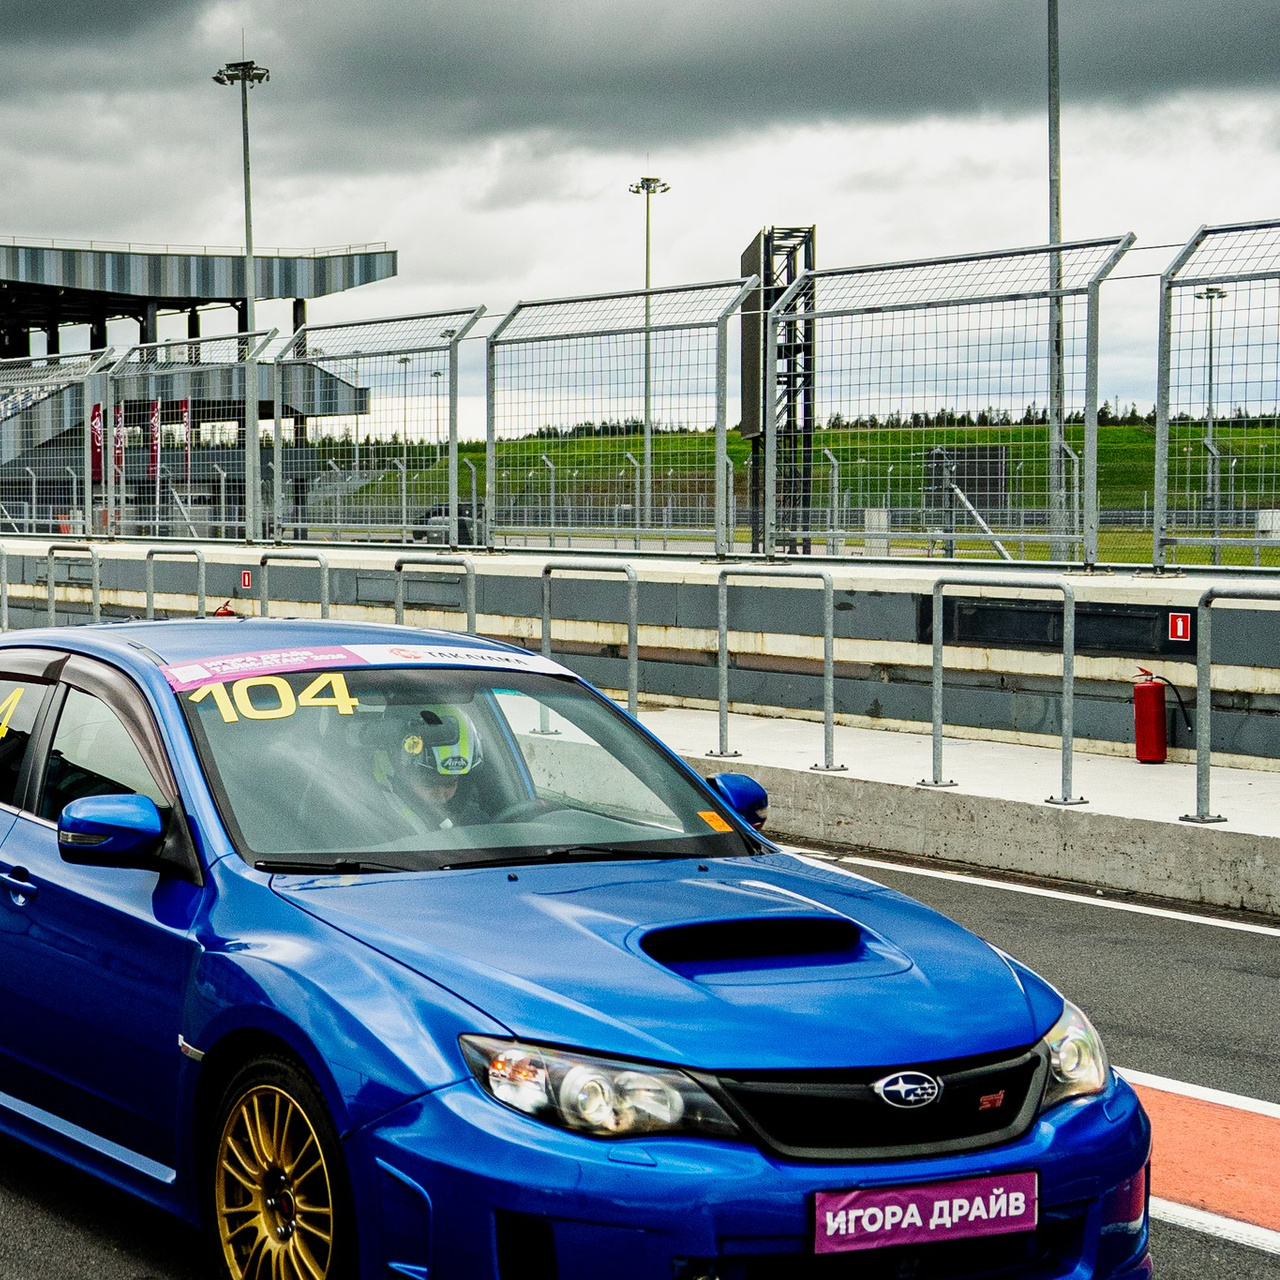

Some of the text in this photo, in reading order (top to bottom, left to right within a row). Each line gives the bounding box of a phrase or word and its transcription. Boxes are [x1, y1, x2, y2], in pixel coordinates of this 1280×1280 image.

[423, 651, 529, 666] TAKAYAMA
[188, 673, 359, 723] 104
[826, 1187, 1026, 1235] ИГОРА ДРАЙВ
